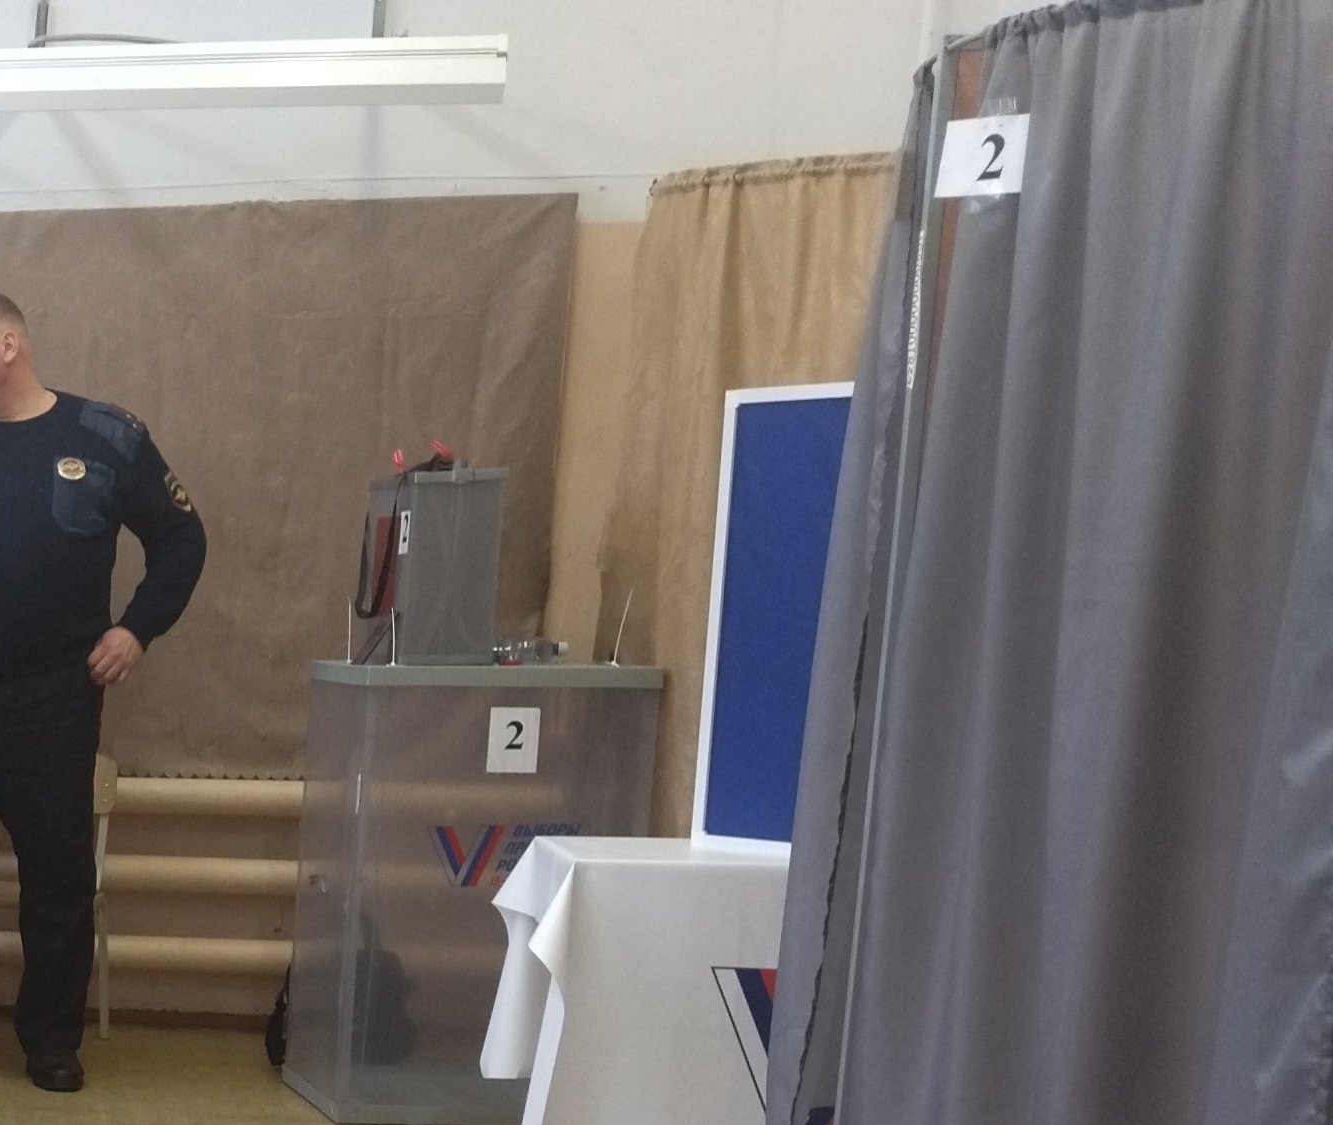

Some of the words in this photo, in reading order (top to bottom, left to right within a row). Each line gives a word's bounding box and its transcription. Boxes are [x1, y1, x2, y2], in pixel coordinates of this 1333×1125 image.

[976, 133, 1005, 181] 2
[504, 720, 524, 750] 2
[513, 823, 582, 836] ВЫБОРЫ
